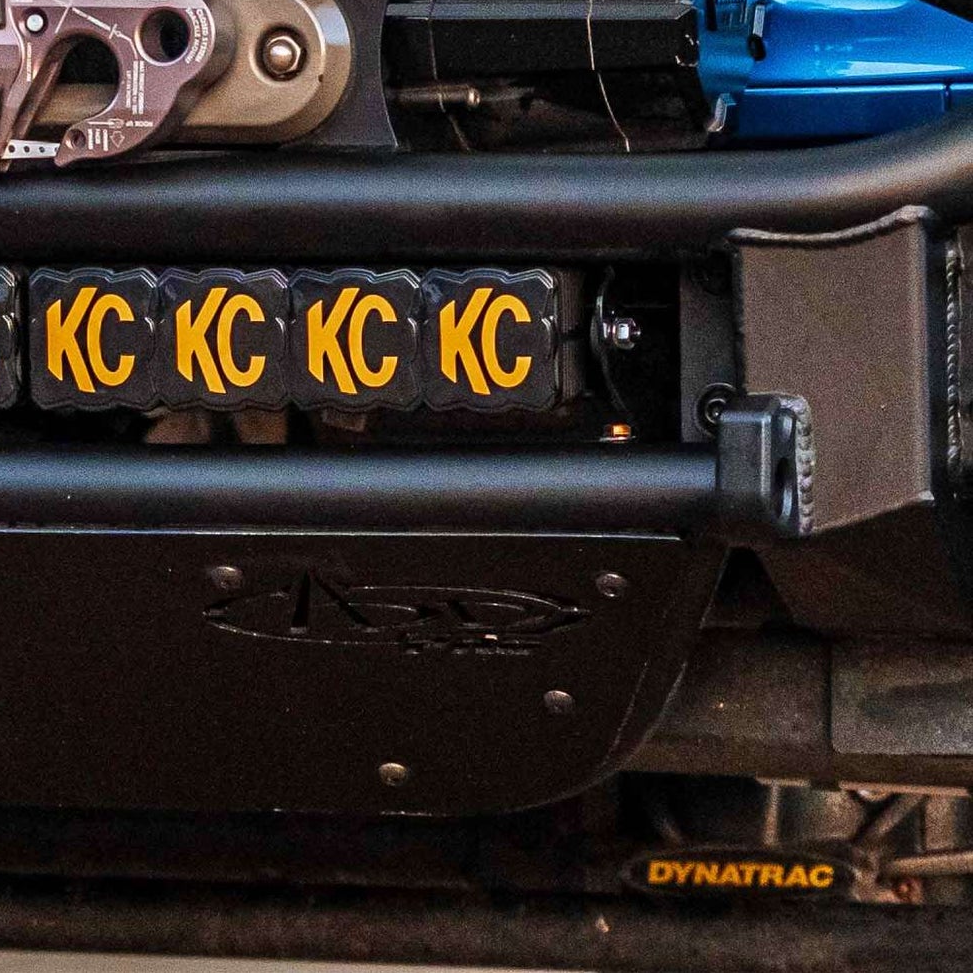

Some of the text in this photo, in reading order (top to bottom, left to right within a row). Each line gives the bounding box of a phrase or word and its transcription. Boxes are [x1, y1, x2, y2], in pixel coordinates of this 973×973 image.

[47, 287, 134, 392] KC
[176, 288, 265, 393] KC
[307, 288, 397, 394] KC
[440, 288, 531, 395] KC
[649, 862, 832, 887] DYNATRAC
